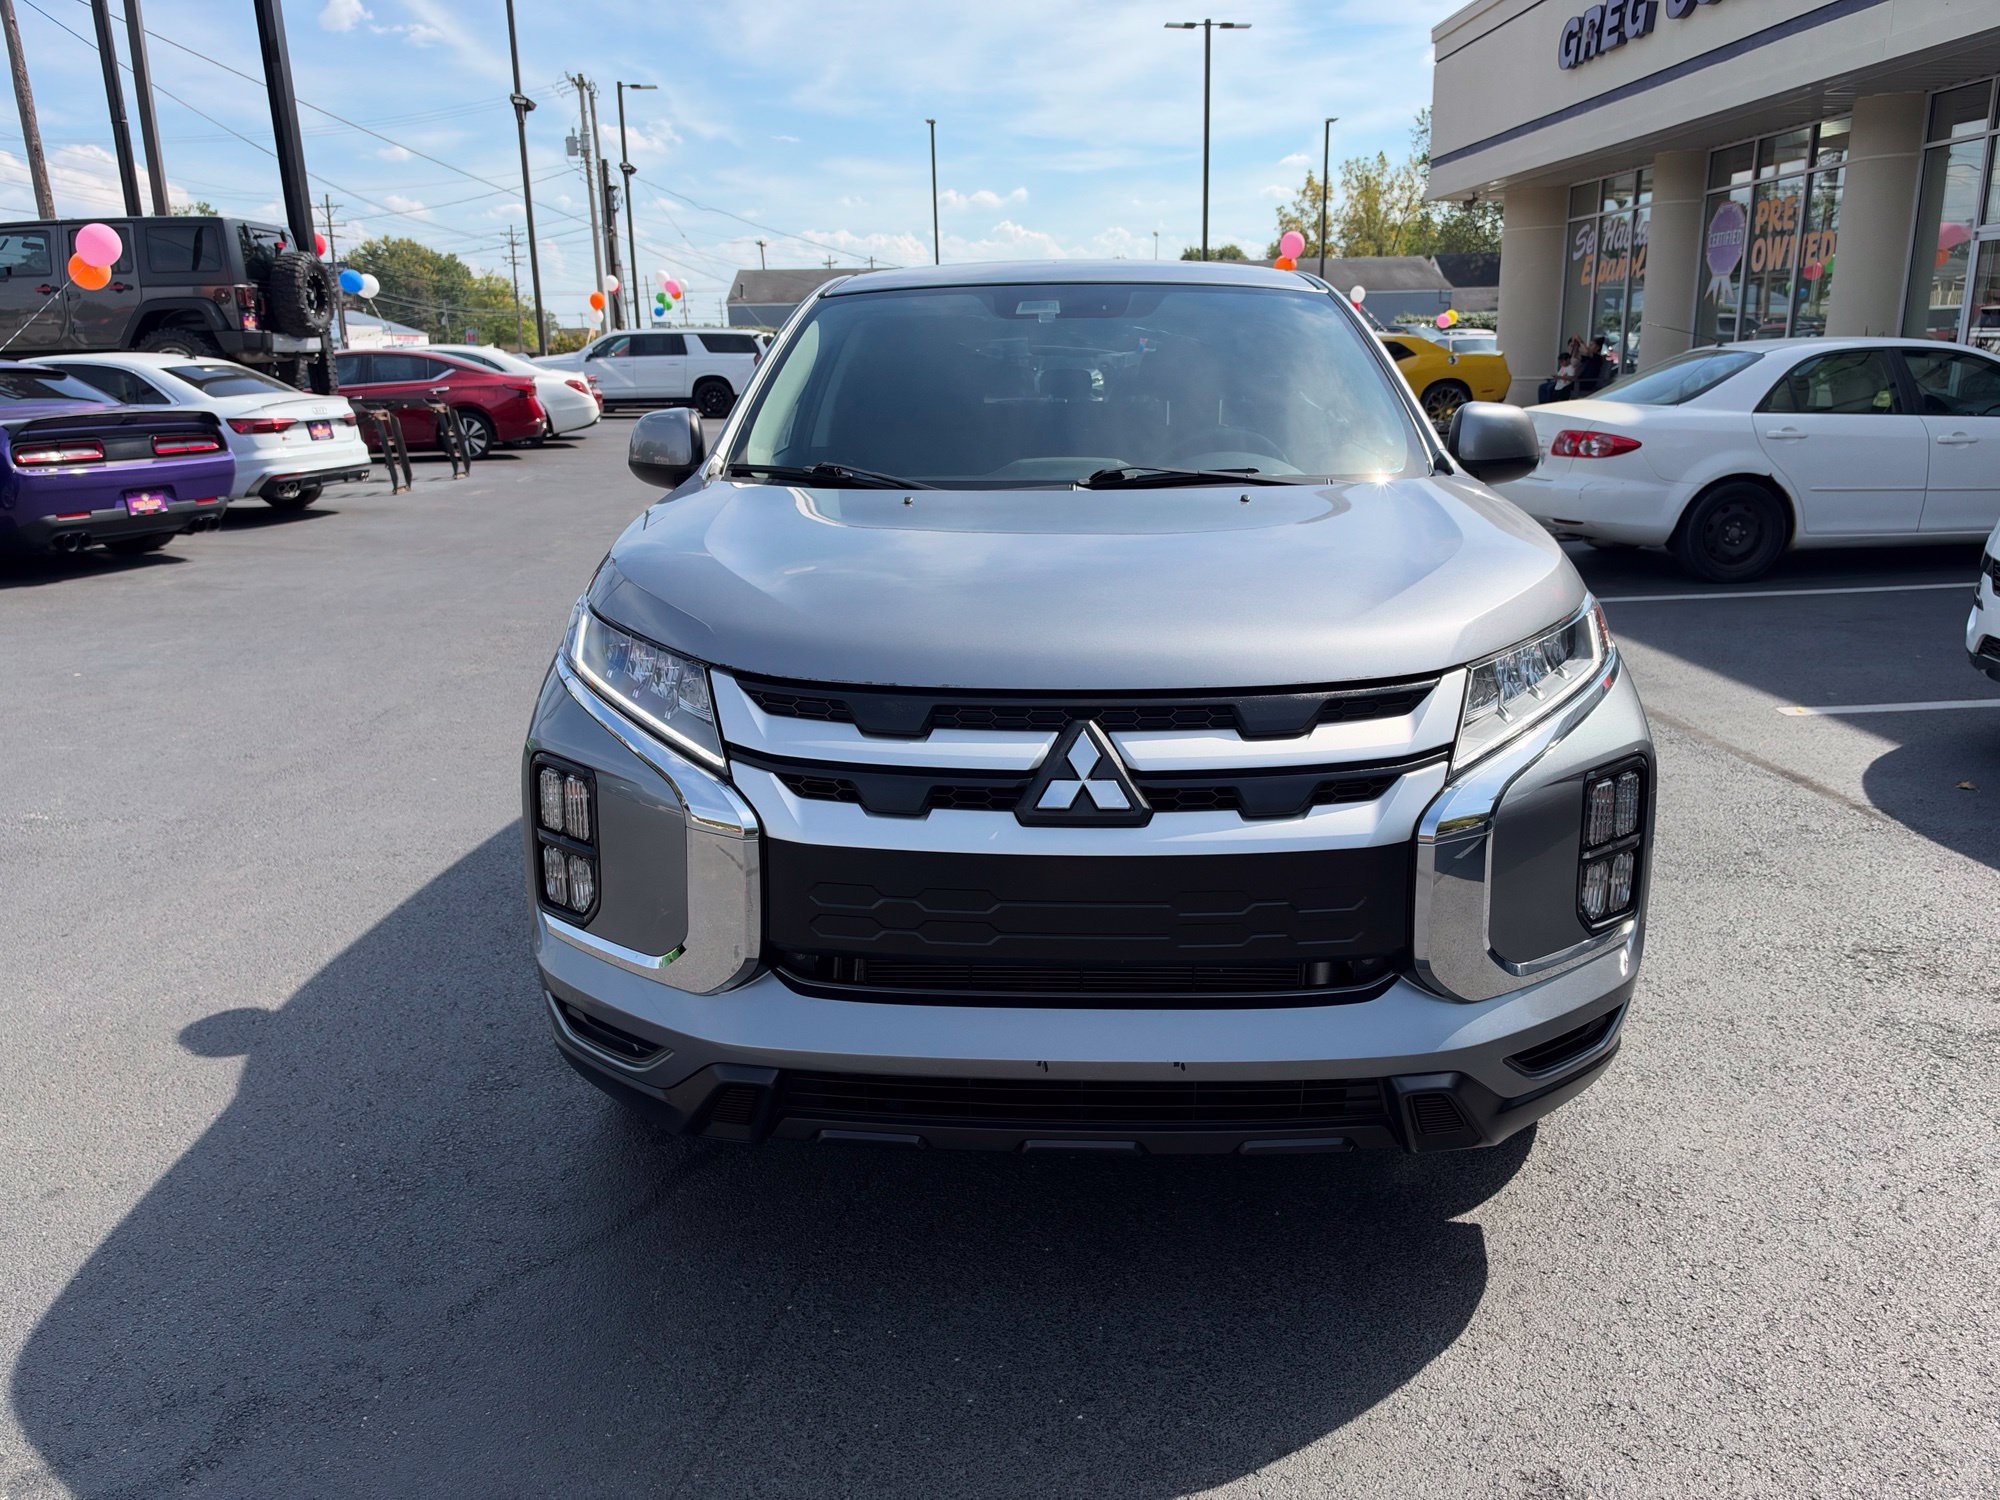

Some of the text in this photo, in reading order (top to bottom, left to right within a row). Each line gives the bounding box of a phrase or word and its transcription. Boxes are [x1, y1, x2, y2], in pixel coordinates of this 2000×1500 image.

[1558, 0, 1656, 70] GREG
[1573, 224, 1595, 261] Se
[1709, 229, 1742, 248] CERTIFIED
